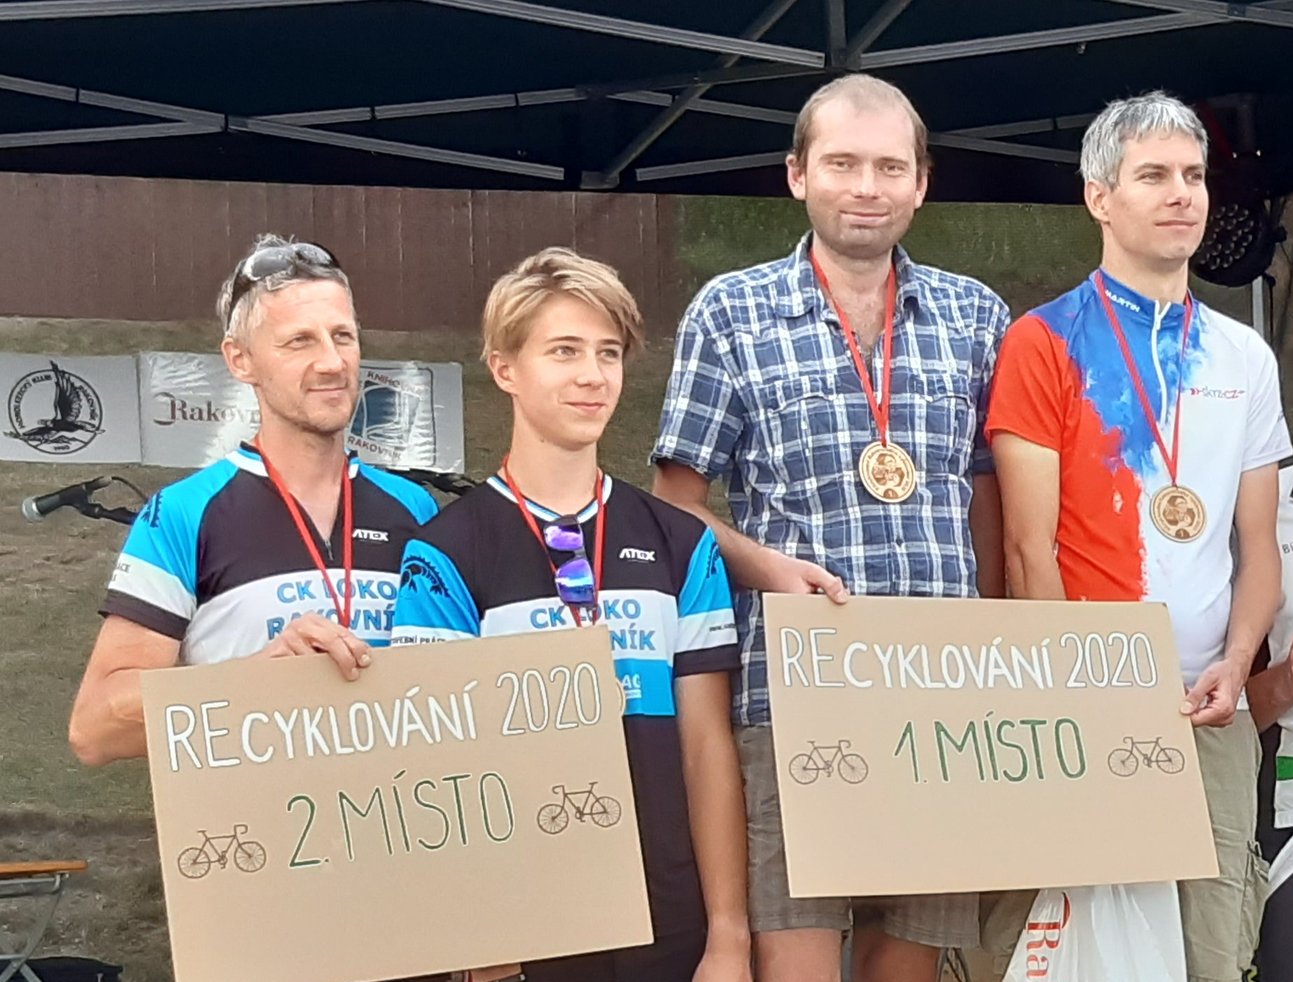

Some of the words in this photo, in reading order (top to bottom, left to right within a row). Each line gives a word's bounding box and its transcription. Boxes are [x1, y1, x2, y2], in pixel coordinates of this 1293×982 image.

[277, 581, 314, 603] CK
[530, 607, 564, 629] CK
[779, 627, 1054, 691] RECYKLOVÁNÍ
[1059, 632, 1158, 689] 2020
[165, 681, 478, 772] RECYKLOVÁNÍ
[496, 663, 602, 738] 2020
